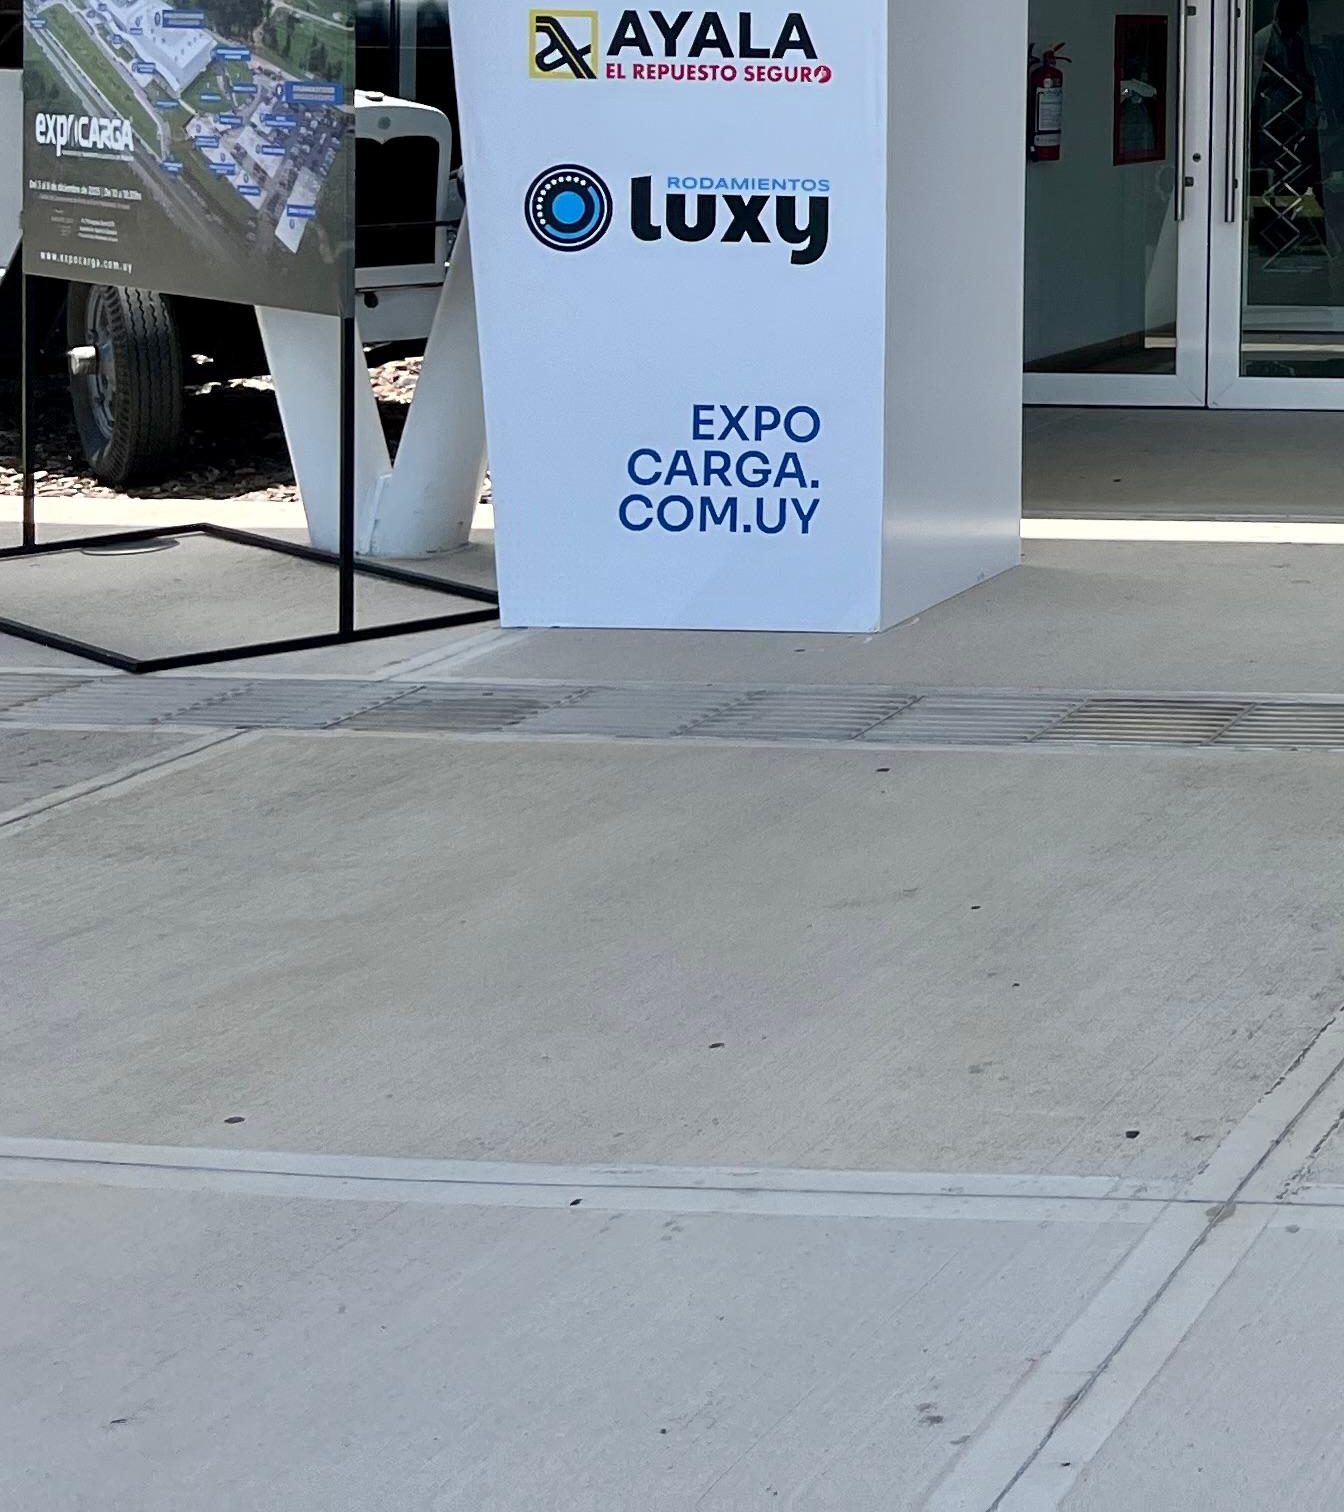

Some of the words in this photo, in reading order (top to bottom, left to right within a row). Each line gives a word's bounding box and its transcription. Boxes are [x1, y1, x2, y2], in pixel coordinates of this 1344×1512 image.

[606, 9, 818, 60] AYALA
[605, 63, 626, 80] EL
[633, 64, 737, 82] REPUESTO
[744, 65, 832, 84] SEGURO
[666, 176, 831, 193] RODAMIENTOS
[630, 175, 830, 265] luxy
[692, 404, 821, 443] EXPO
[627, 448, 820, 489] CARGA.
[619, 494, 821, 534] COM.UY
